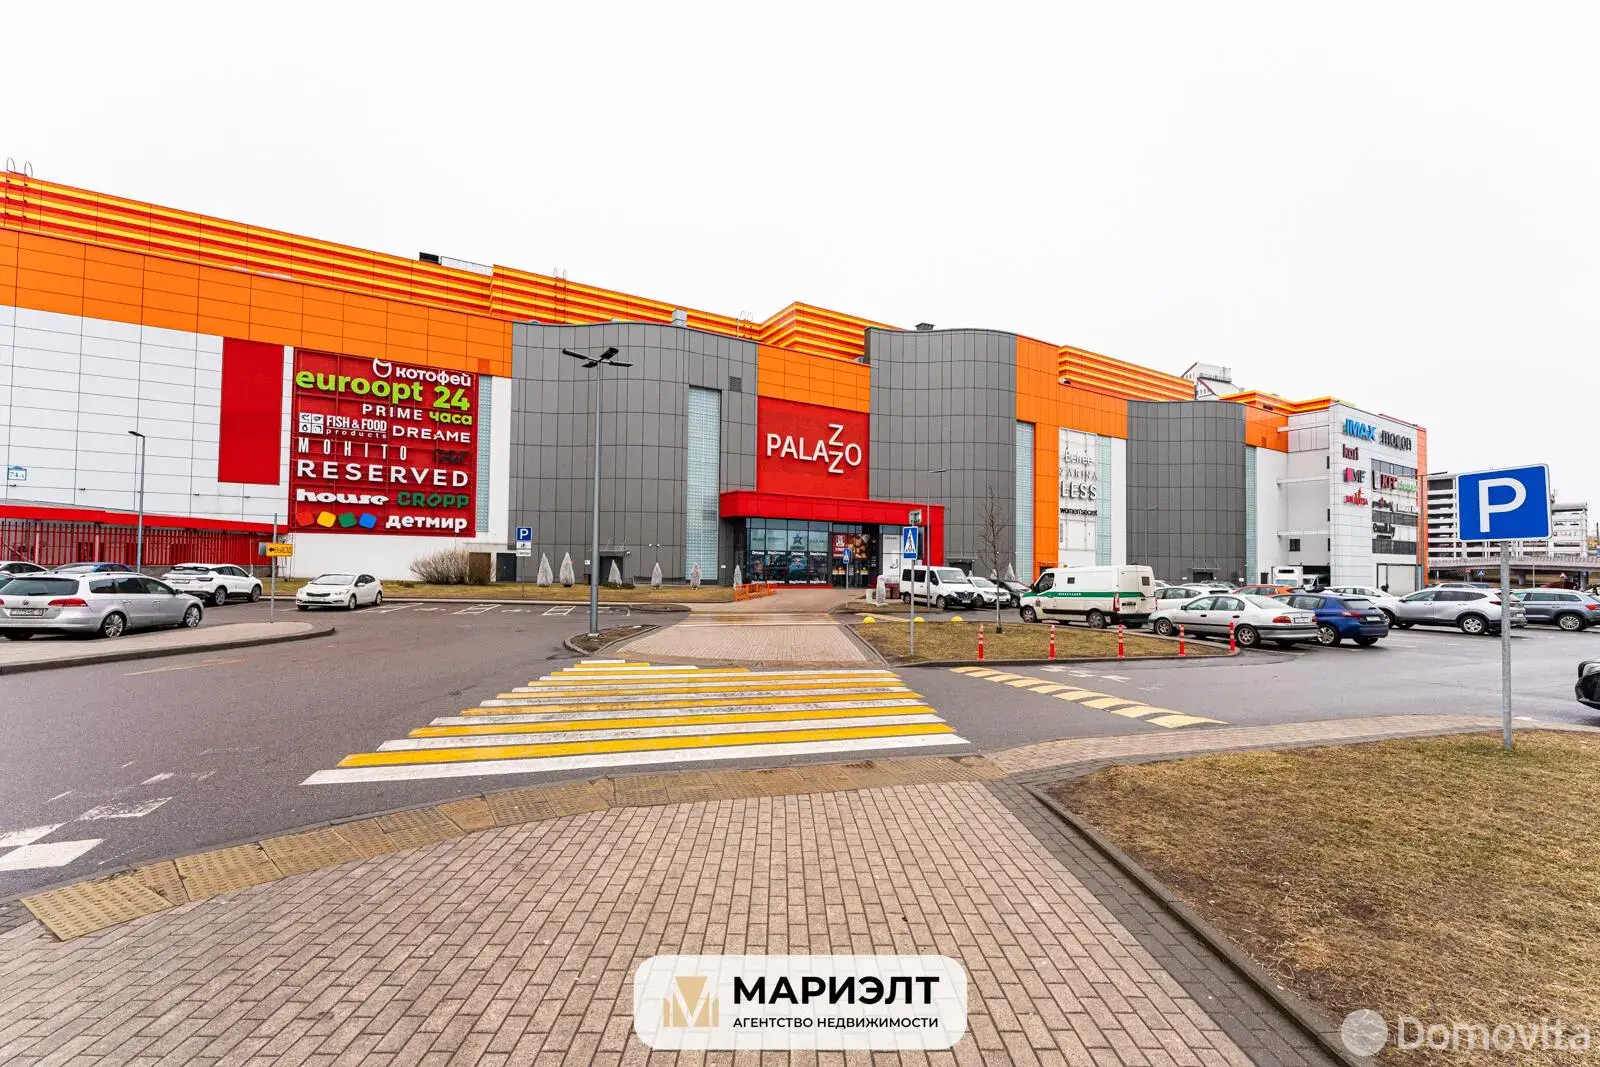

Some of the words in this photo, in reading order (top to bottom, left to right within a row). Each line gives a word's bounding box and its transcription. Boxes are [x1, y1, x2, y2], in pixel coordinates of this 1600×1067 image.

[396, 366, 472, 387] котофей
[295, 370, 424, 404] euroopt
[433, 385, 471, 411] 24
[362, 403, 423, 421] PRIME
[429, 411, 473, 426] часа
[326, 415, 350, 428] FISH
[351, 419, 360, 429] &
[361, 418, 388, 432] FOOD
[1343, 418, 1377, 442] IMAX
[326, 429, 387, 439] products
[392, 425, 471, 443] DREAME
[298, 437, 407, 461] MOHITO
[297, 459, 469, 488] RESERVED
[1381, 474, 1398, 490] KFC
[296, 488, 390, 506] house
[397, 491, 470, 508] CROPP
[1060, 480, 1098, 501] LESS
[1478, 477, 1527, 533] P
[385, 514, 468, 533] детмир
[519, 528, 529, 540] P
